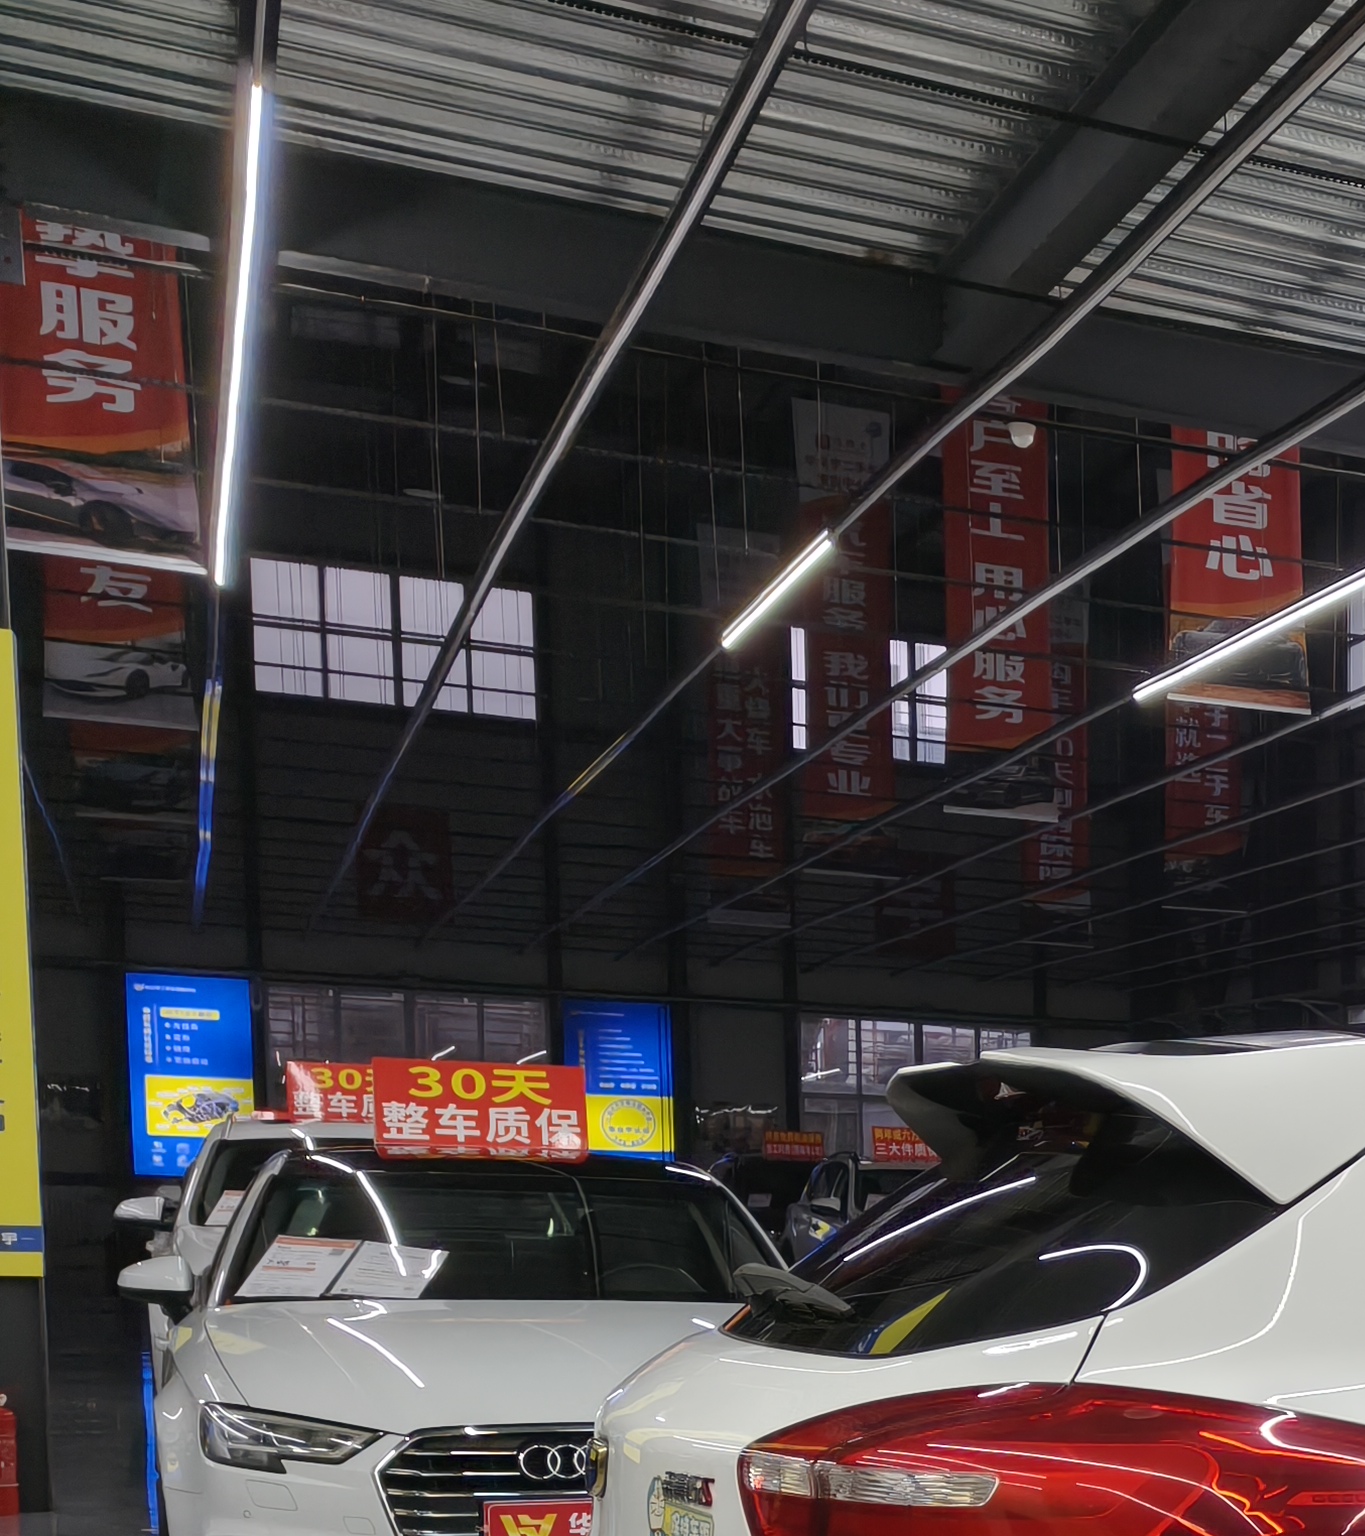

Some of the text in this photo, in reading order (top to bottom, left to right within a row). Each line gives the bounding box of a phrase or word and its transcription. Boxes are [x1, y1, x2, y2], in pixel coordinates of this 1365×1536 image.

[310, 1067, 373, 1093] 30
[408, 1066, 552, 1106] 30天
[382, 1101, 582, 1148] 整车质保
